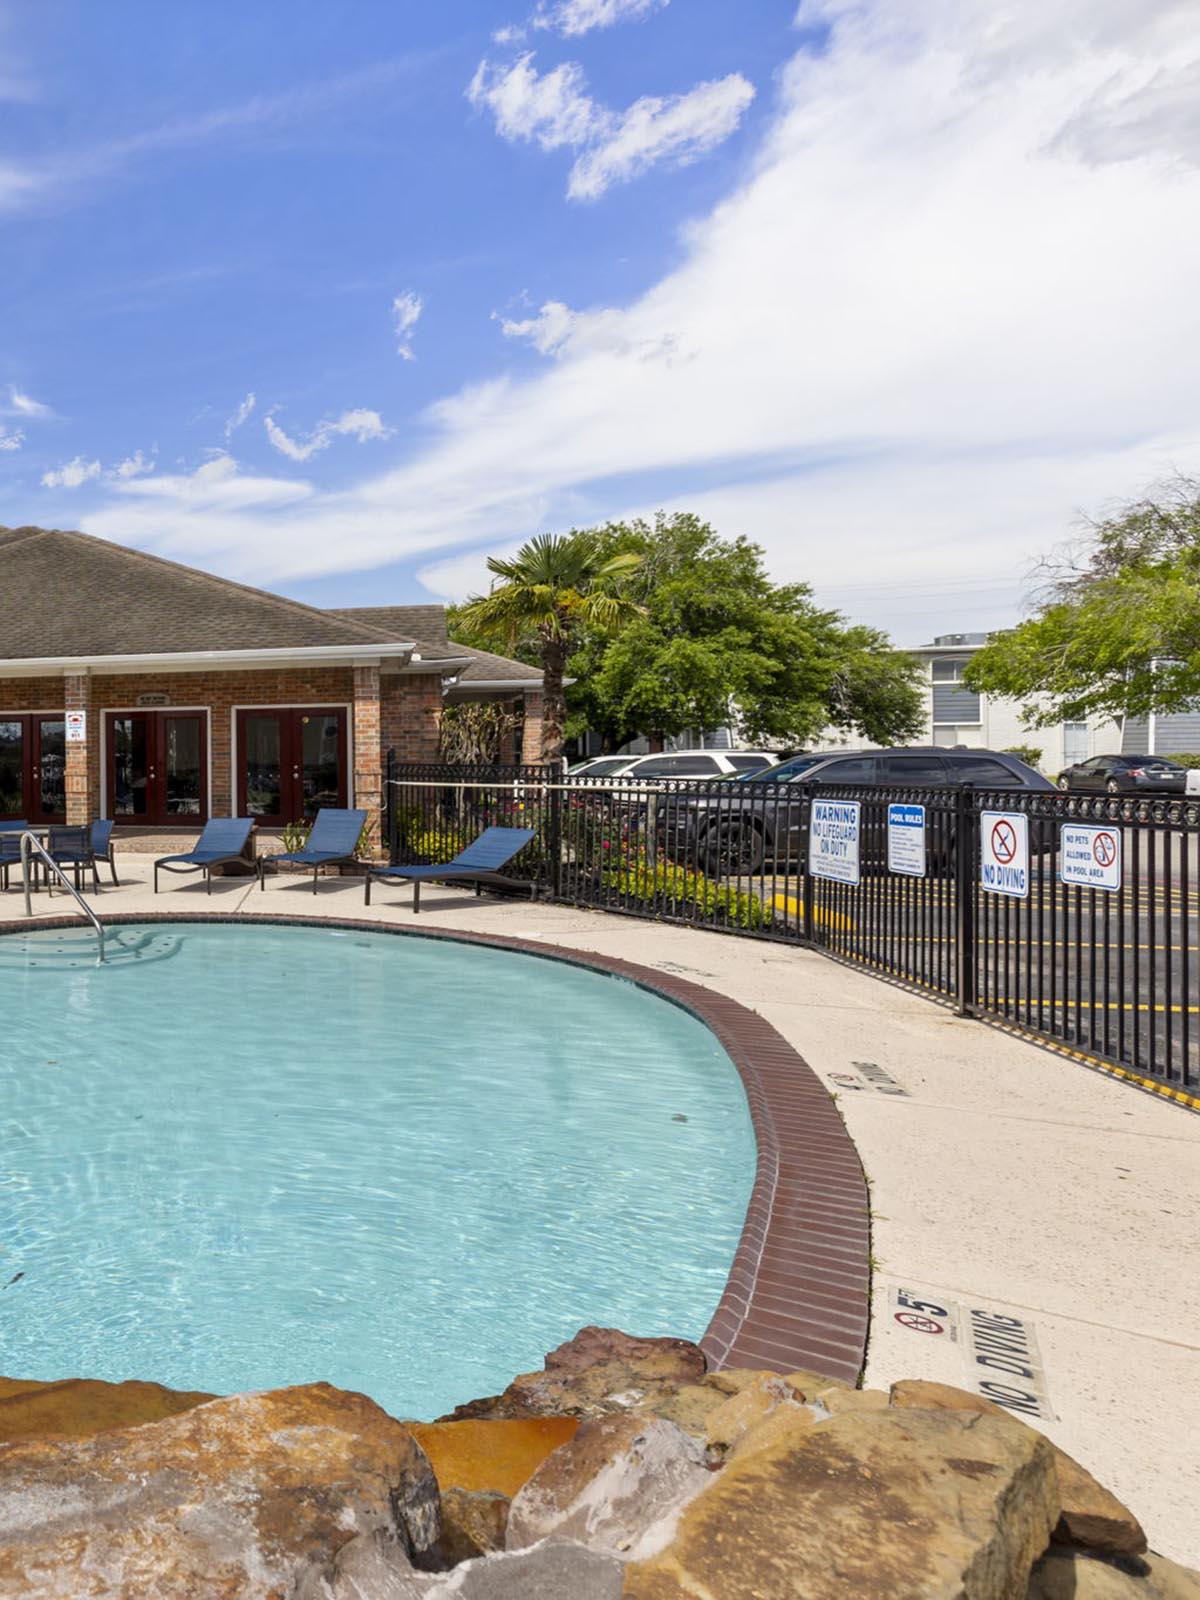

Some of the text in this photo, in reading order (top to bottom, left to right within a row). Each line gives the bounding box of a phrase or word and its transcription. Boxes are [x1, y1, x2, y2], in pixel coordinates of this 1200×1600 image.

[815, 805, 856, 824] WARNING
[812, 821, 857, 842] NO LIFEGUARD
[1066, 835, 1089, 845] NO PETS
[820, 838, 847, 857] ON DUTY
[1066, 850, 1091, 861] ALLOWED
[984, 864, 1025, 889] NO DIVING
[1073, 866, 1087, 876] POOL
[1089, 868, 1104, 878] AREA
[898, 1296, 948, 1317] 5
[970, 1309, 1041, 1417] NO DIVING
